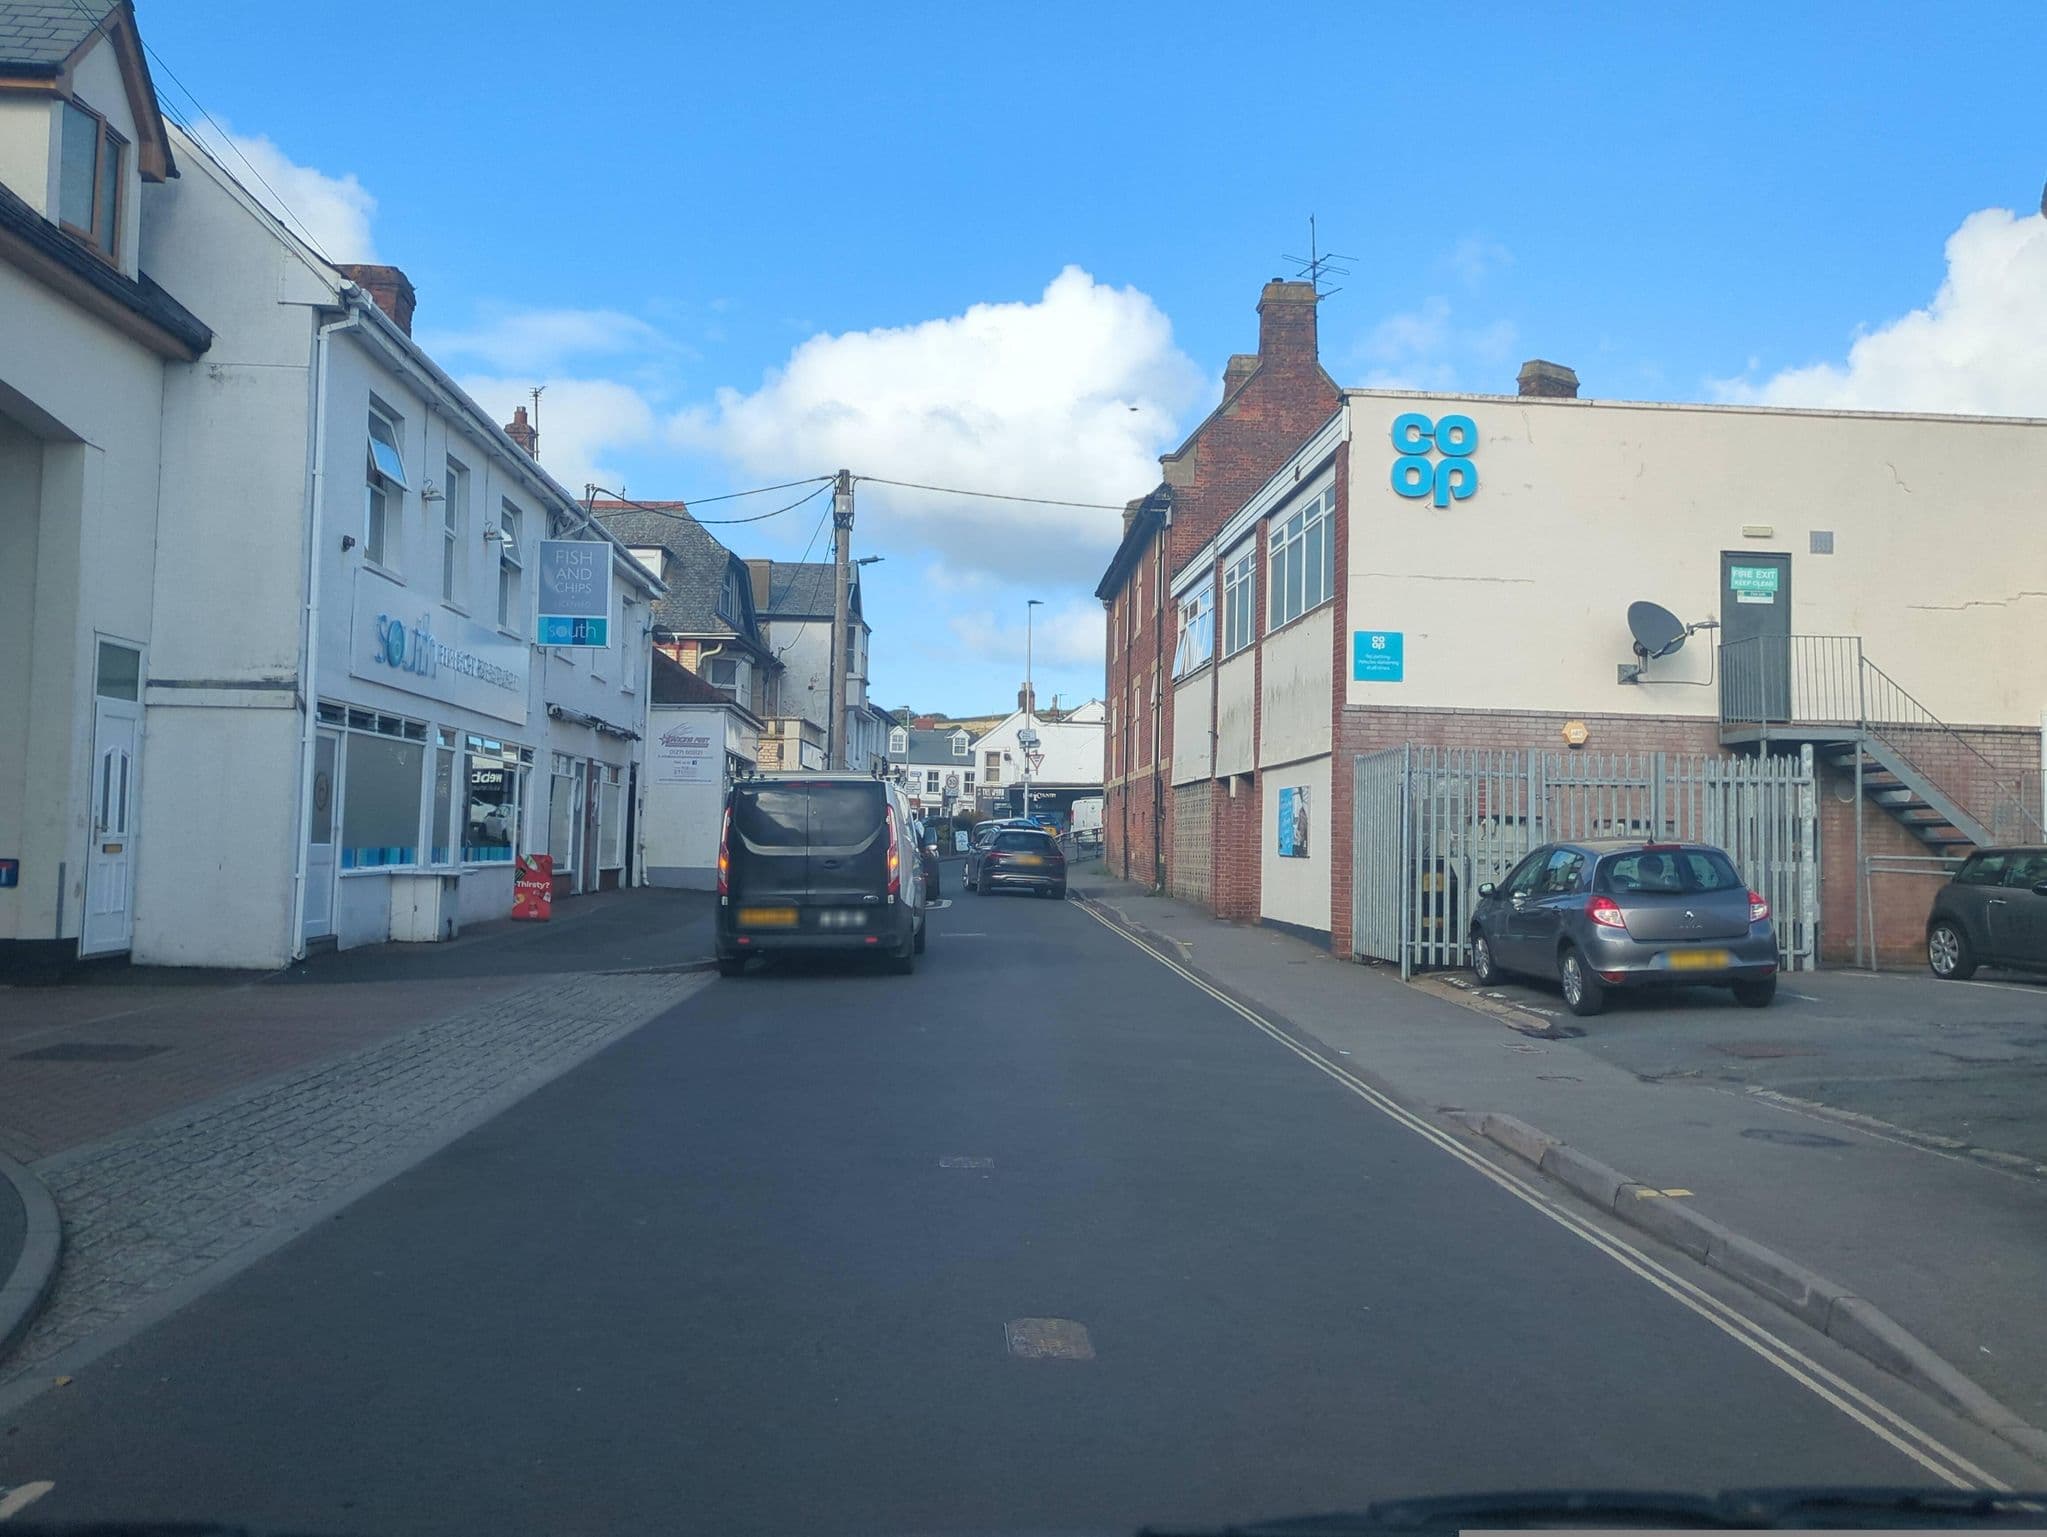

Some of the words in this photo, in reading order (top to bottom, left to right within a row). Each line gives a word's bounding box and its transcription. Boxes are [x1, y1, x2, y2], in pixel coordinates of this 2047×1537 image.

[555, 550, 593, 565] FISH
[556, 567, 593, 580] AND
[1733, 570, 1753, 578] FIRE
[1756, 571, 1776, 579] EXIT
[554, 582, 592, 593] CHIPS
[548, 620, 597, 639] south
[516, 880, 550, 890] Thirsty?
